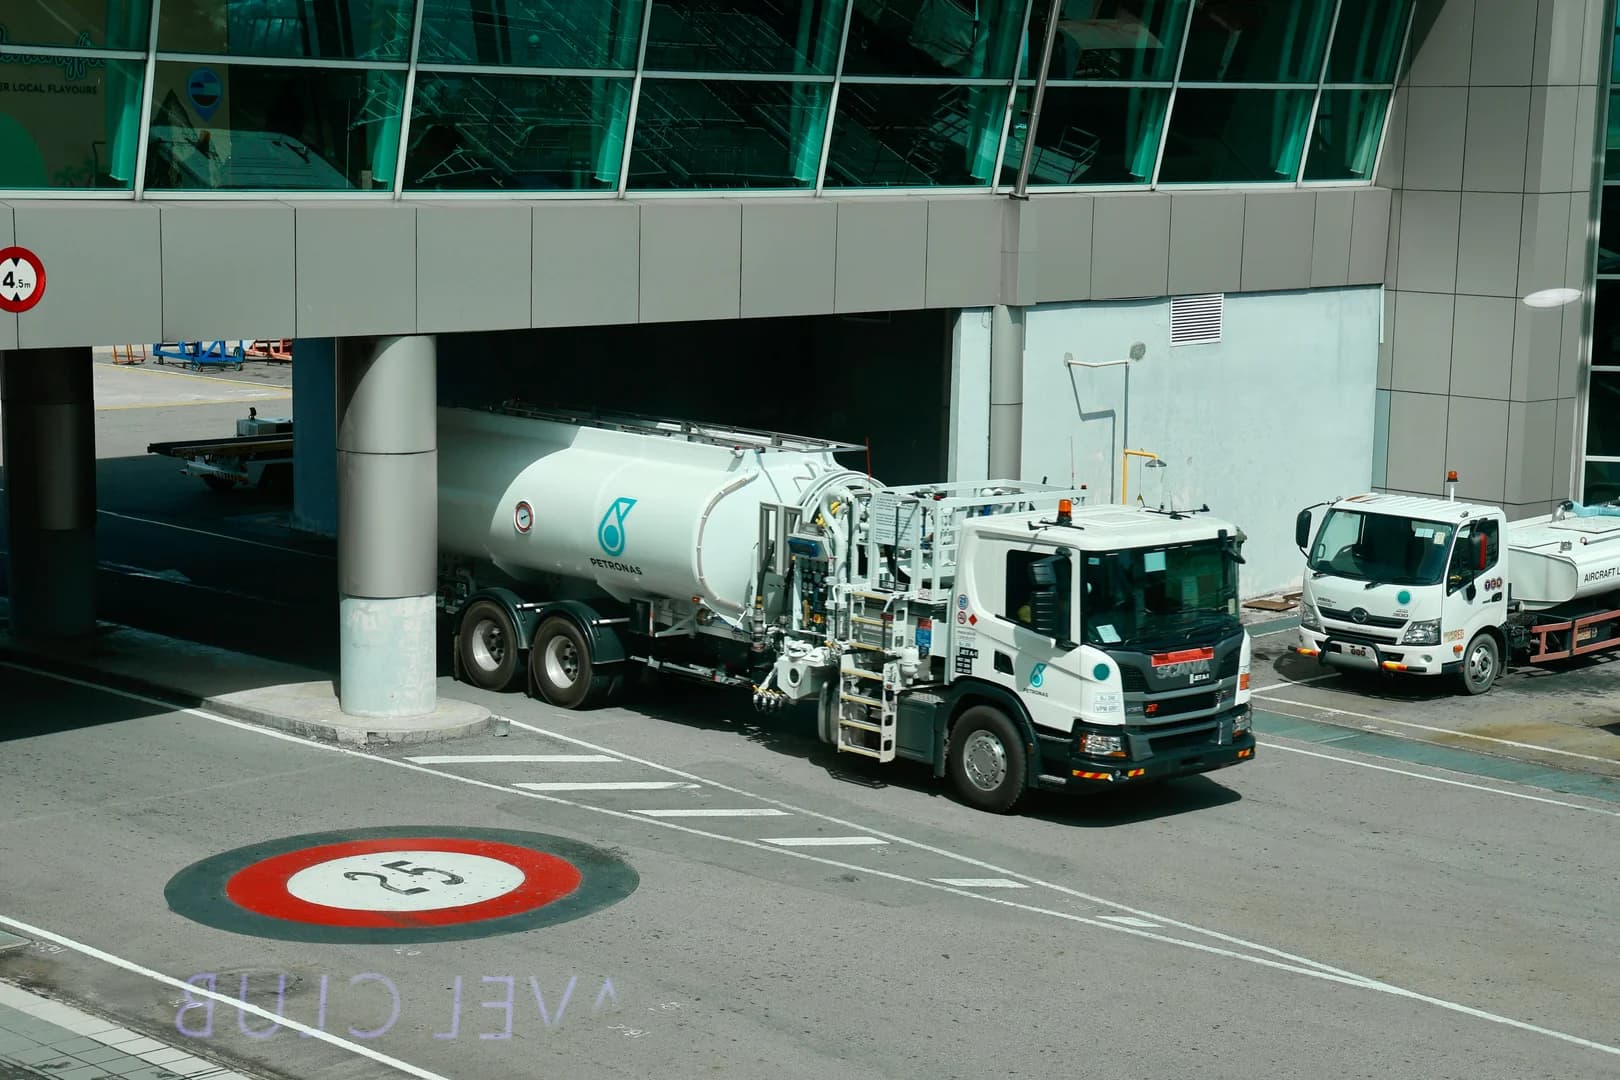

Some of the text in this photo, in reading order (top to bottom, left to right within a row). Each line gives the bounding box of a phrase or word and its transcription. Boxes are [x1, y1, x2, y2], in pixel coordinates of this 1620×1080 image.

[12, 83, 45, 93] LOCAL
[47, 84, 97, 95] FLAVOURS
[590, 557, 642, 575] PETRONAS
[1583, 567, 1616, 583] AIRCRAFT
[1156, 660, 1211, 679] SCANIA
[343, 860, 465, 896] 25
